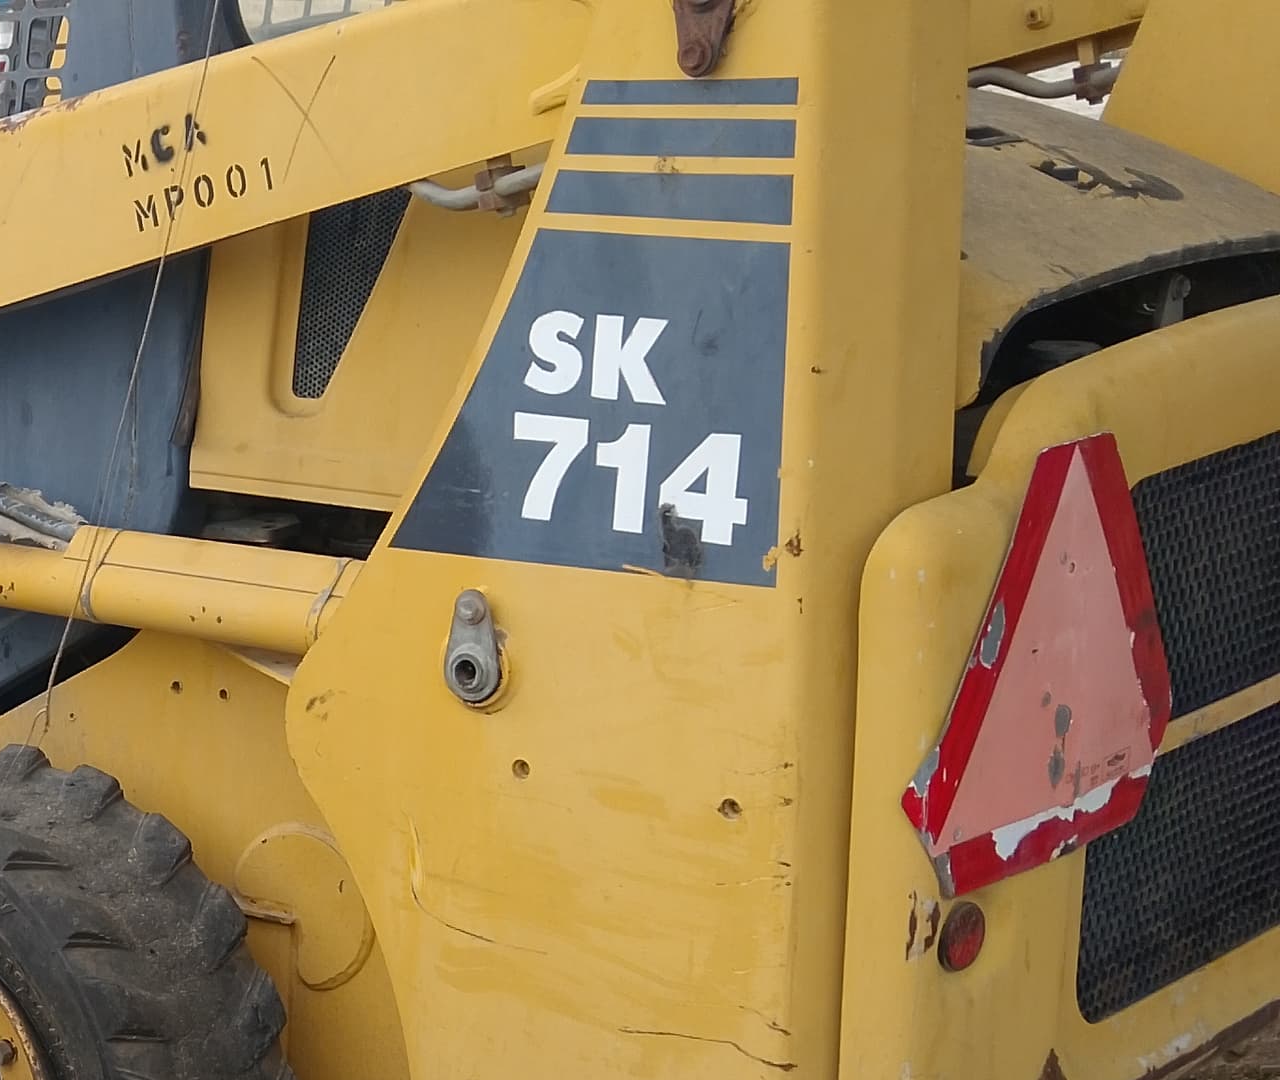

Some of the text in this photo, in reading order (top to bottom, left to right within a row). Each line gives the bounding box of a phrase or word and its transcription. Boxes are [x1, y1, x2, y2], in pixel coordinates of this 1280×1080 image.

[122, 112, 207, 178] MCA
[134, 156, 274, 232] MP001
[523, 310, 669, 405] SK
[513, 411, 749, 546] 714
